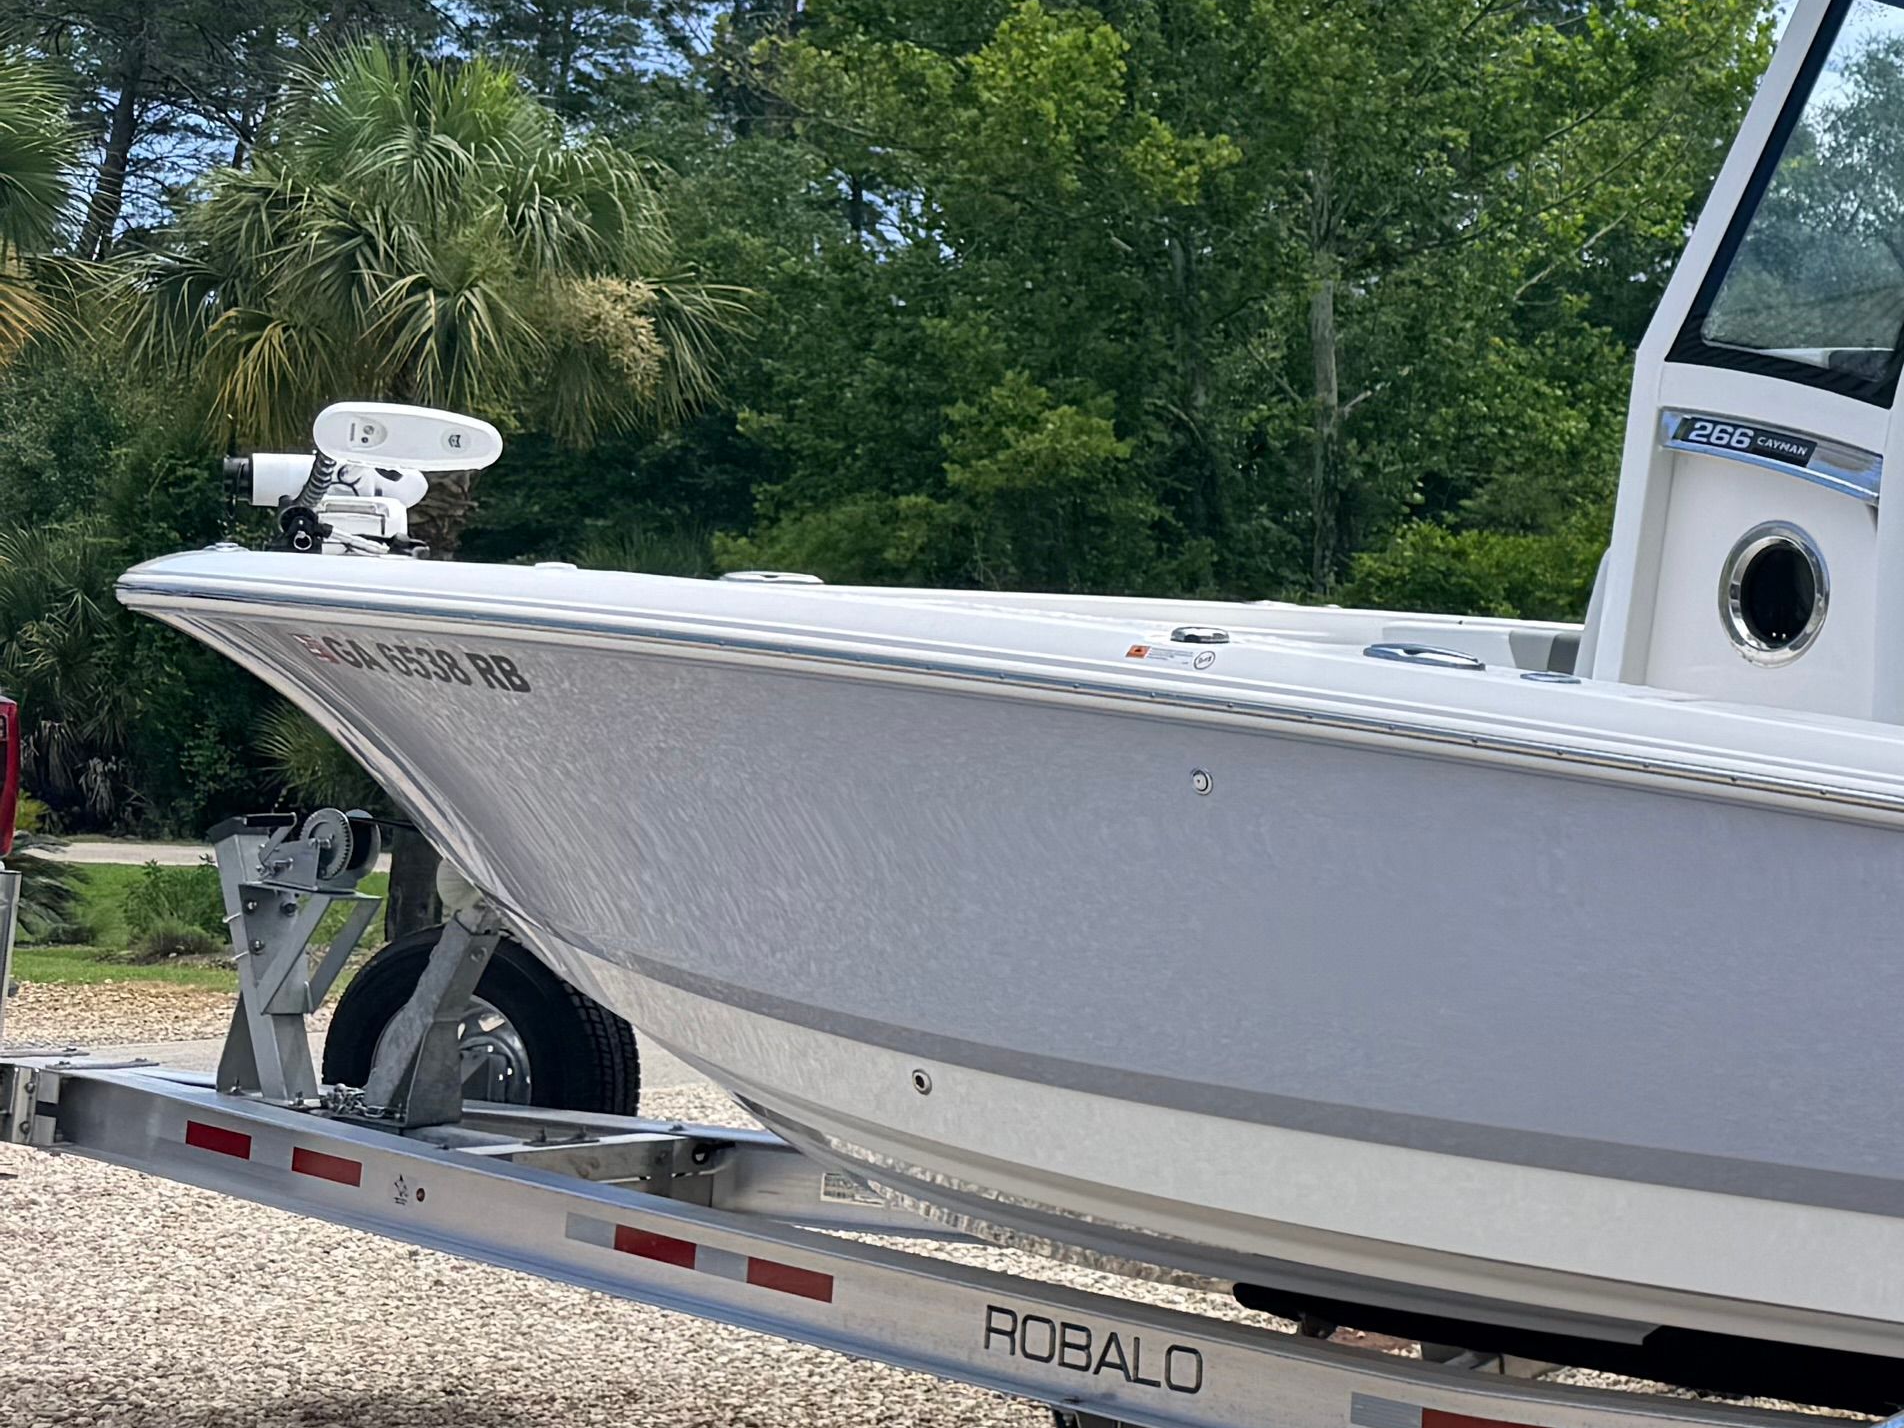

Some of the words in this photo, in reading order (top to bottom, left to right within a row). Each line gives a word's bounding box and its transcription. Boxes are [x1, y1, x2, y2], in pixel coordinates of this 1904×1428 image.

[1688, 421, 1754, 449] 266
[1756, 435, 1809, 457] CAYMAN
[321, 636, 389, 673] GA
[376, 642, 473, 686] 6538
[465, 652, 532, 693] RB
[983, 1304, 1203, 1394] ROBALO
